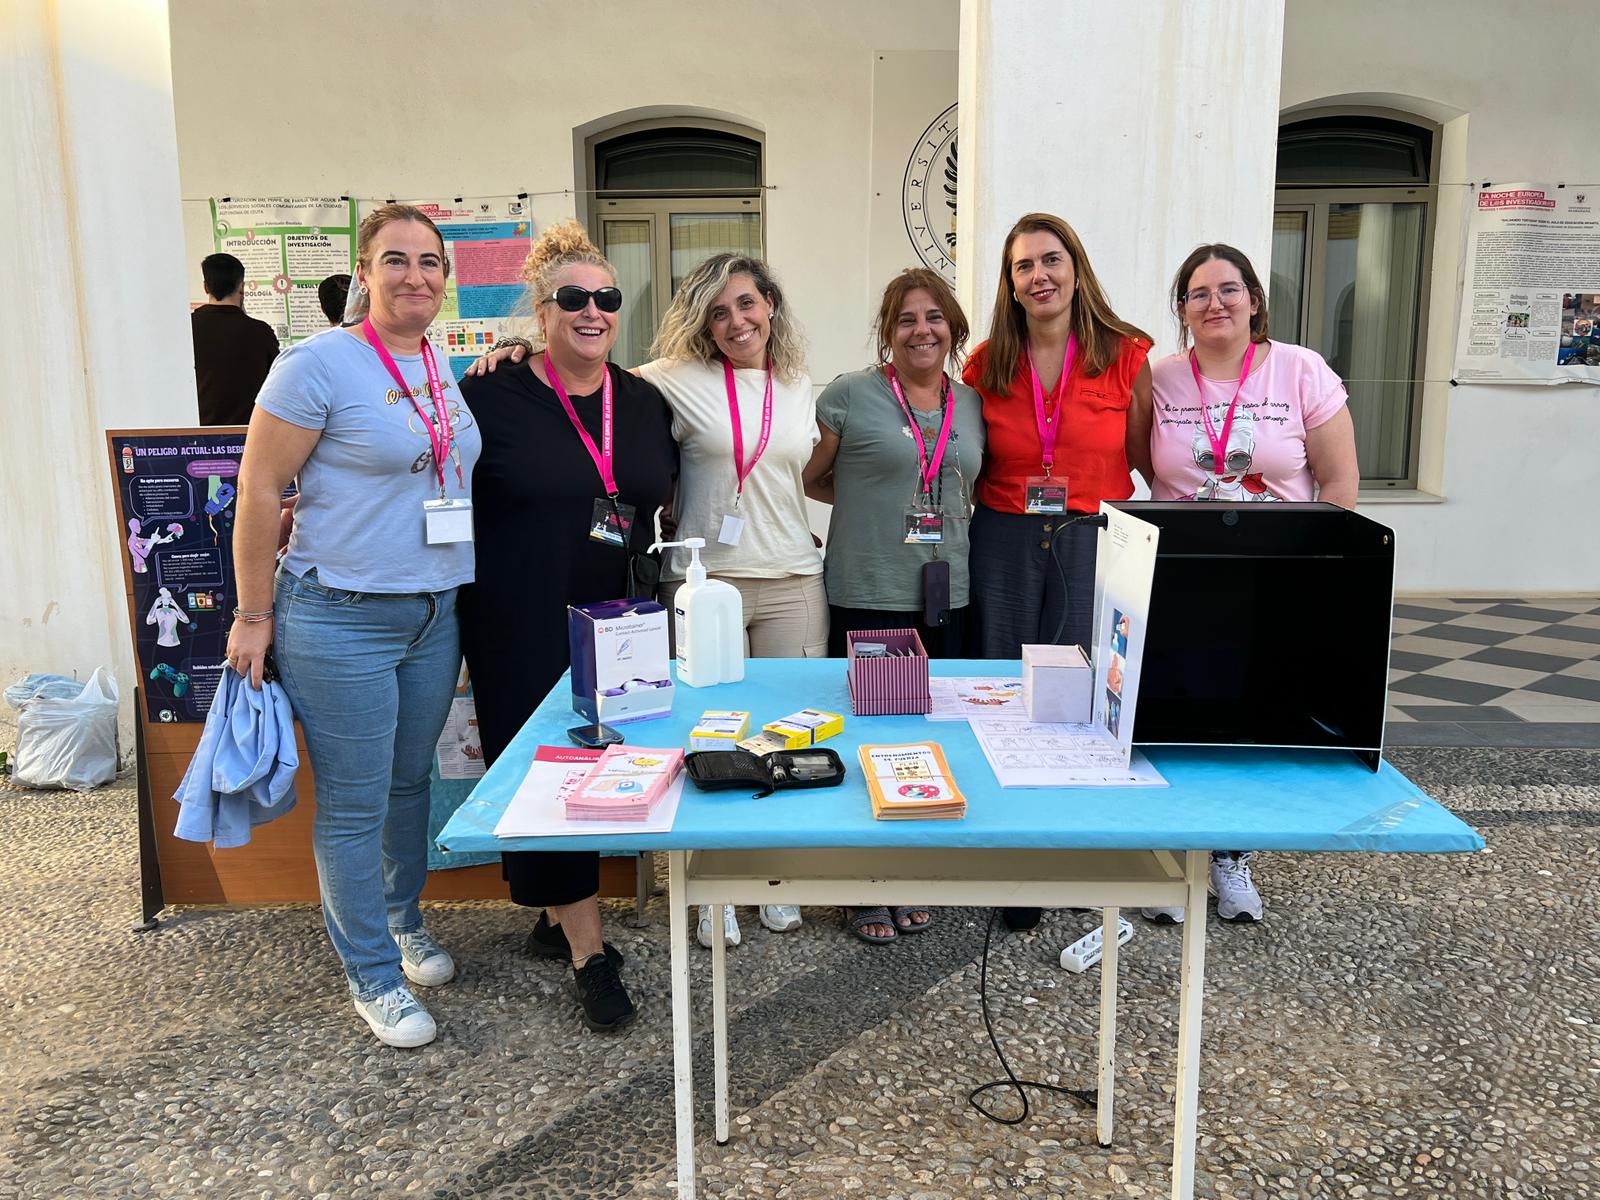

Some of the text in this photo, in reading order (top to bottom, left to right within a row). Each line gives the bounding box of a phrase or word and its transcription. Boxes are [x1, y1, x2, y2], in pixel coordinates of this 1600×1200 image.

[226, 238, 276, 247] INTRODUCCIÓN
[1242, 403, 1260, 412] pasa
[1262, 397, 1269, 407] el
[1270, 402, 1289, 412] arroz
[1253, 412, 1261, 422] la
[135, 448, 147, 457] UN
[148, 447, 178, 456] PELIGRO
[181, 446, 211, 456] ACTUAL:
[212, 445, 226, 455] LAS
